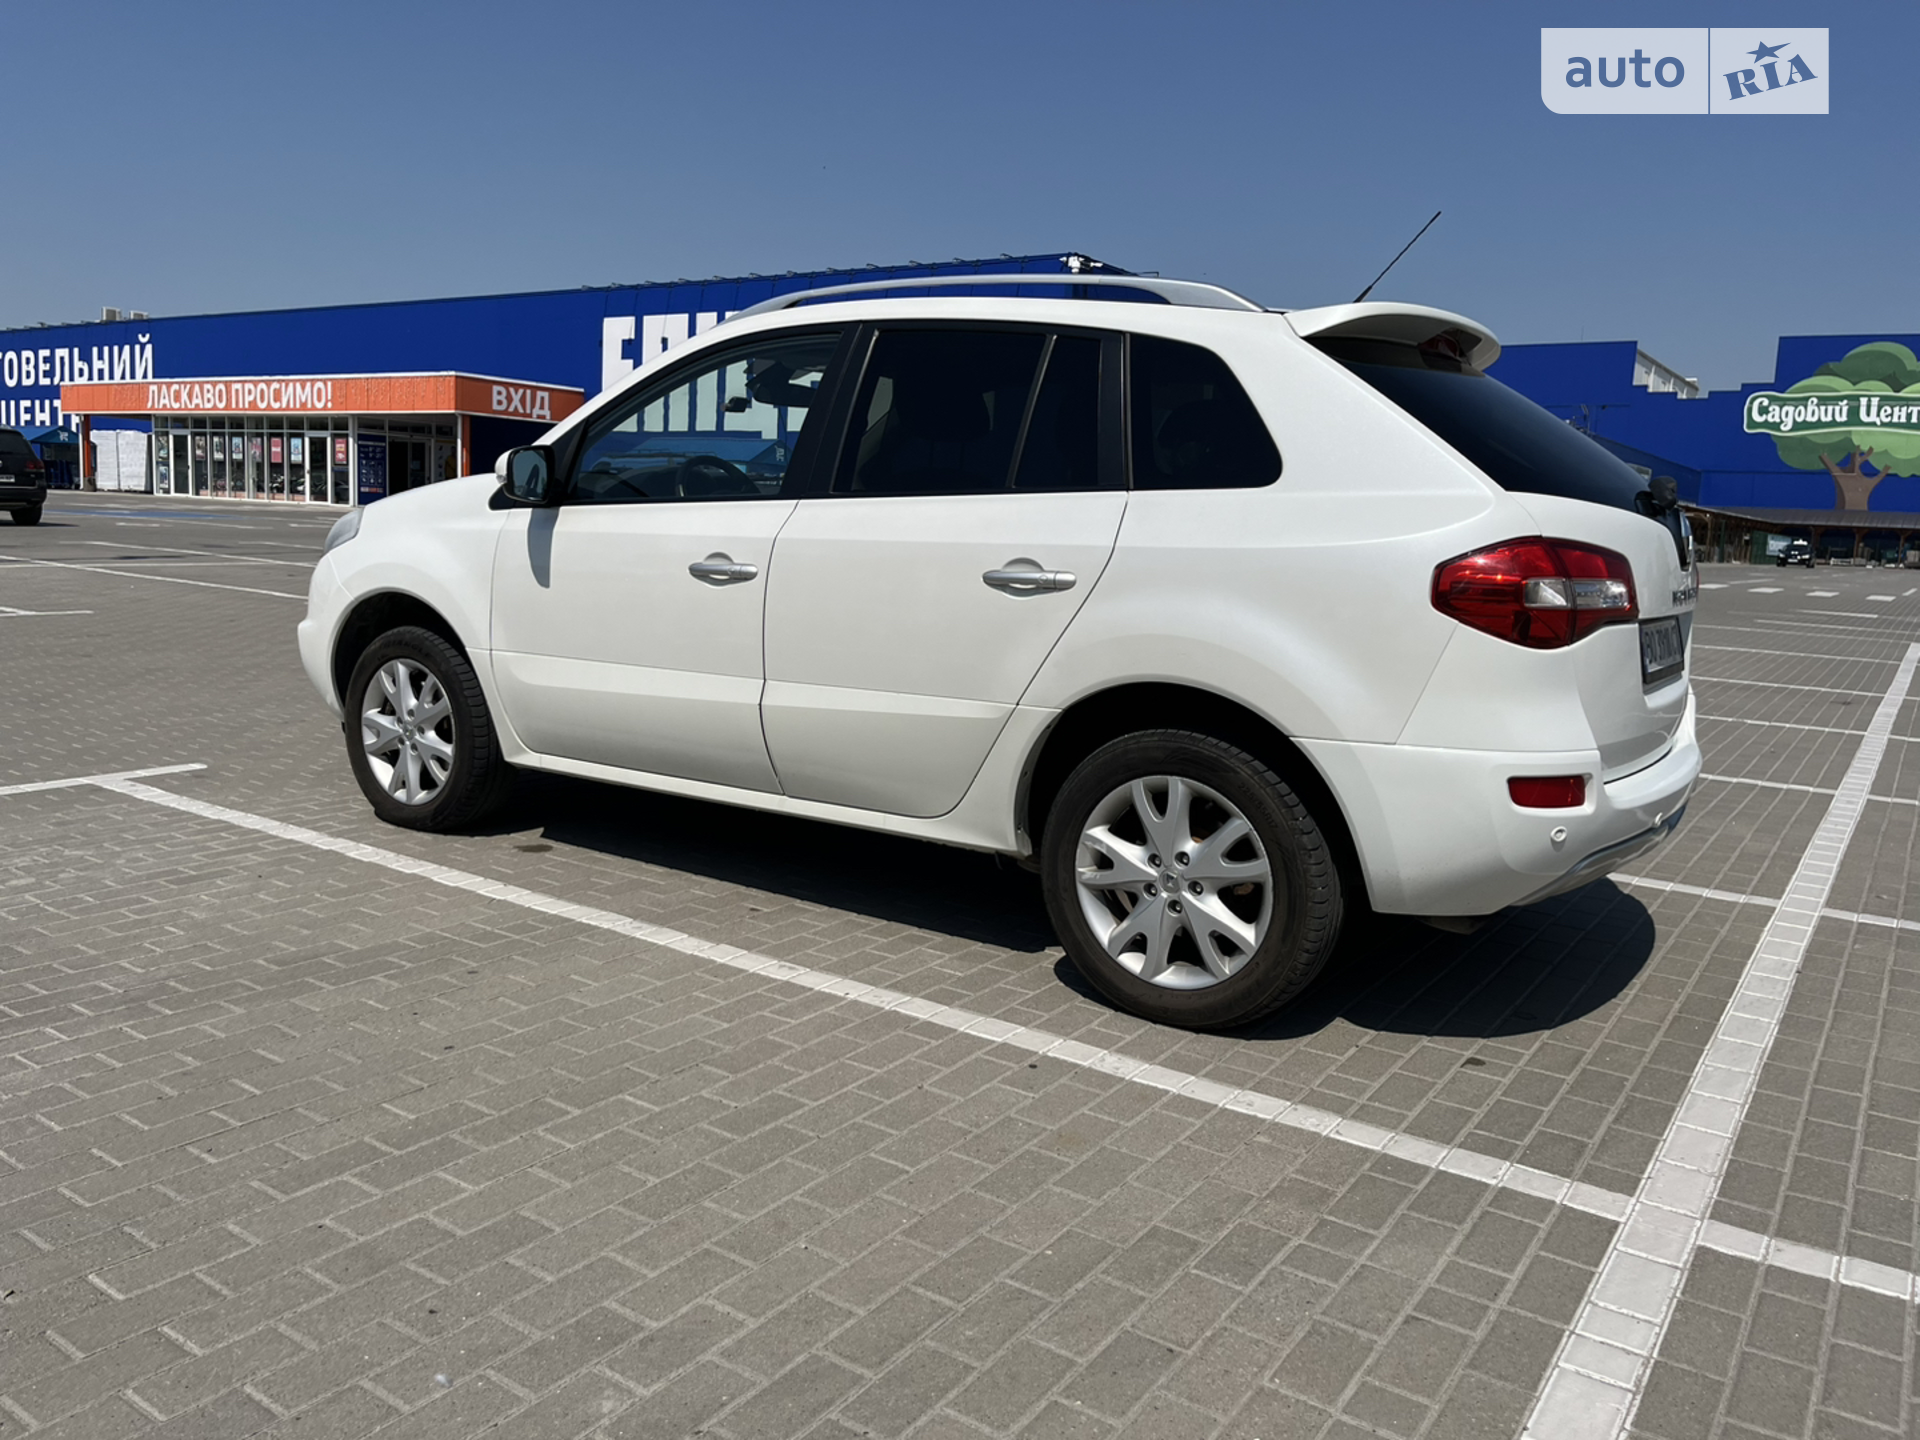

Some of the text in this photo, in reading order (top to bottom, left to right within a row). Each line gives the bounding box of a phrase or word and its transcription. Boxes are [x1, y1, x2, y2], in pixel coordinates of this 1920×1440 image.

[0, 333, 153, 387] ОВЕЛЬНИЙ
[147, 381, 332, 409] ЛАСКАВО ПРОСИМО!
[492, 385, 550, 420] ВХІД
[1751, 397, 1849, 431] Садовий
